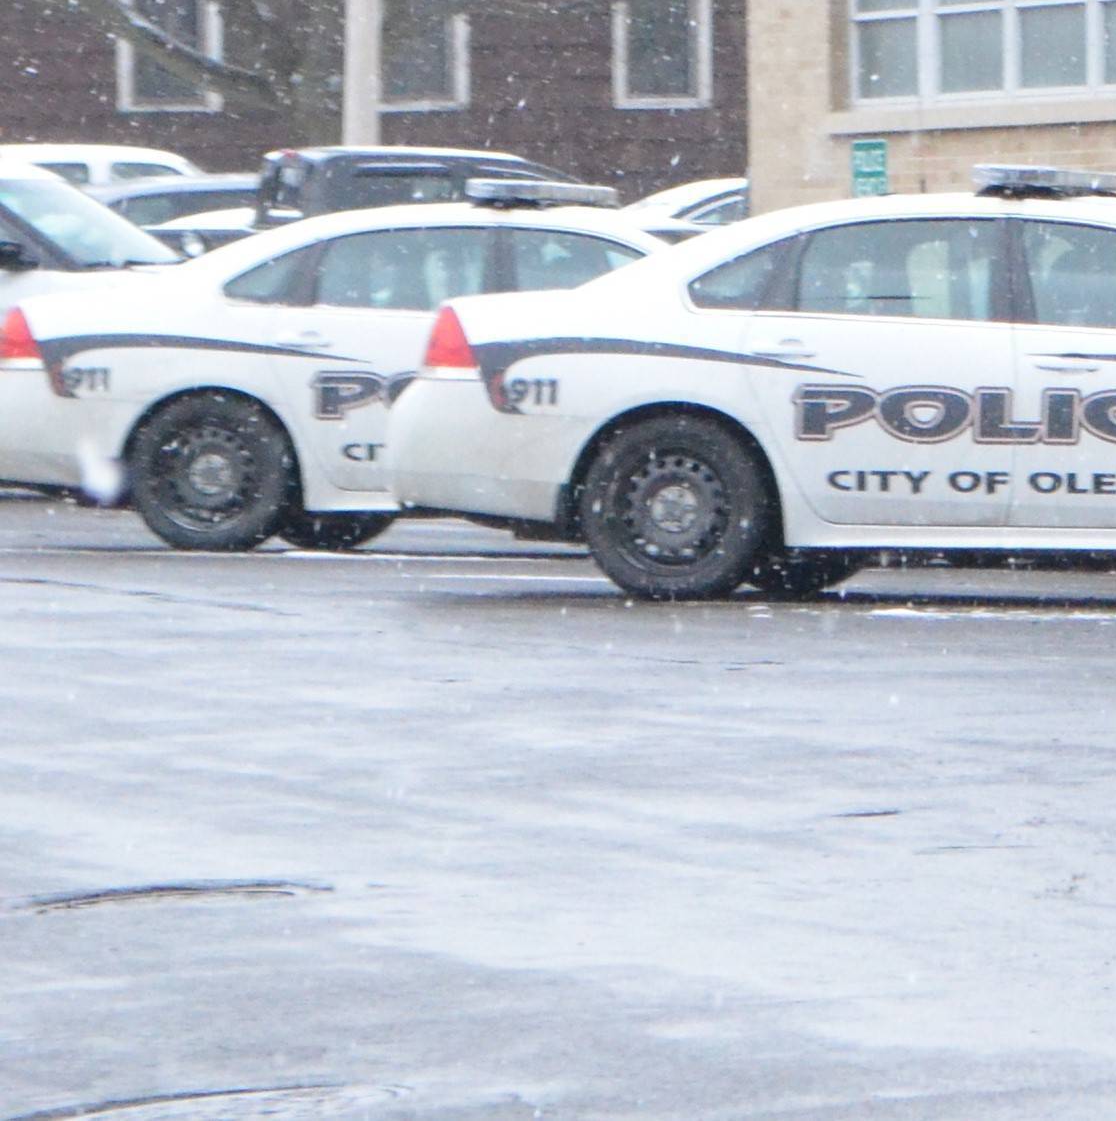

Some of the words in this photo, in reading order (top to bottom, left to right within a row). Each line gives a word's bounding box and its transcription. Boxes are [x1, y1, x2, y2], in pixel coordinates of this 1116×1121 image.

[510, 377, 559, 406] 911
[827, 469, 931, 495] CITY
[947, 470, 1010, 496] OF
